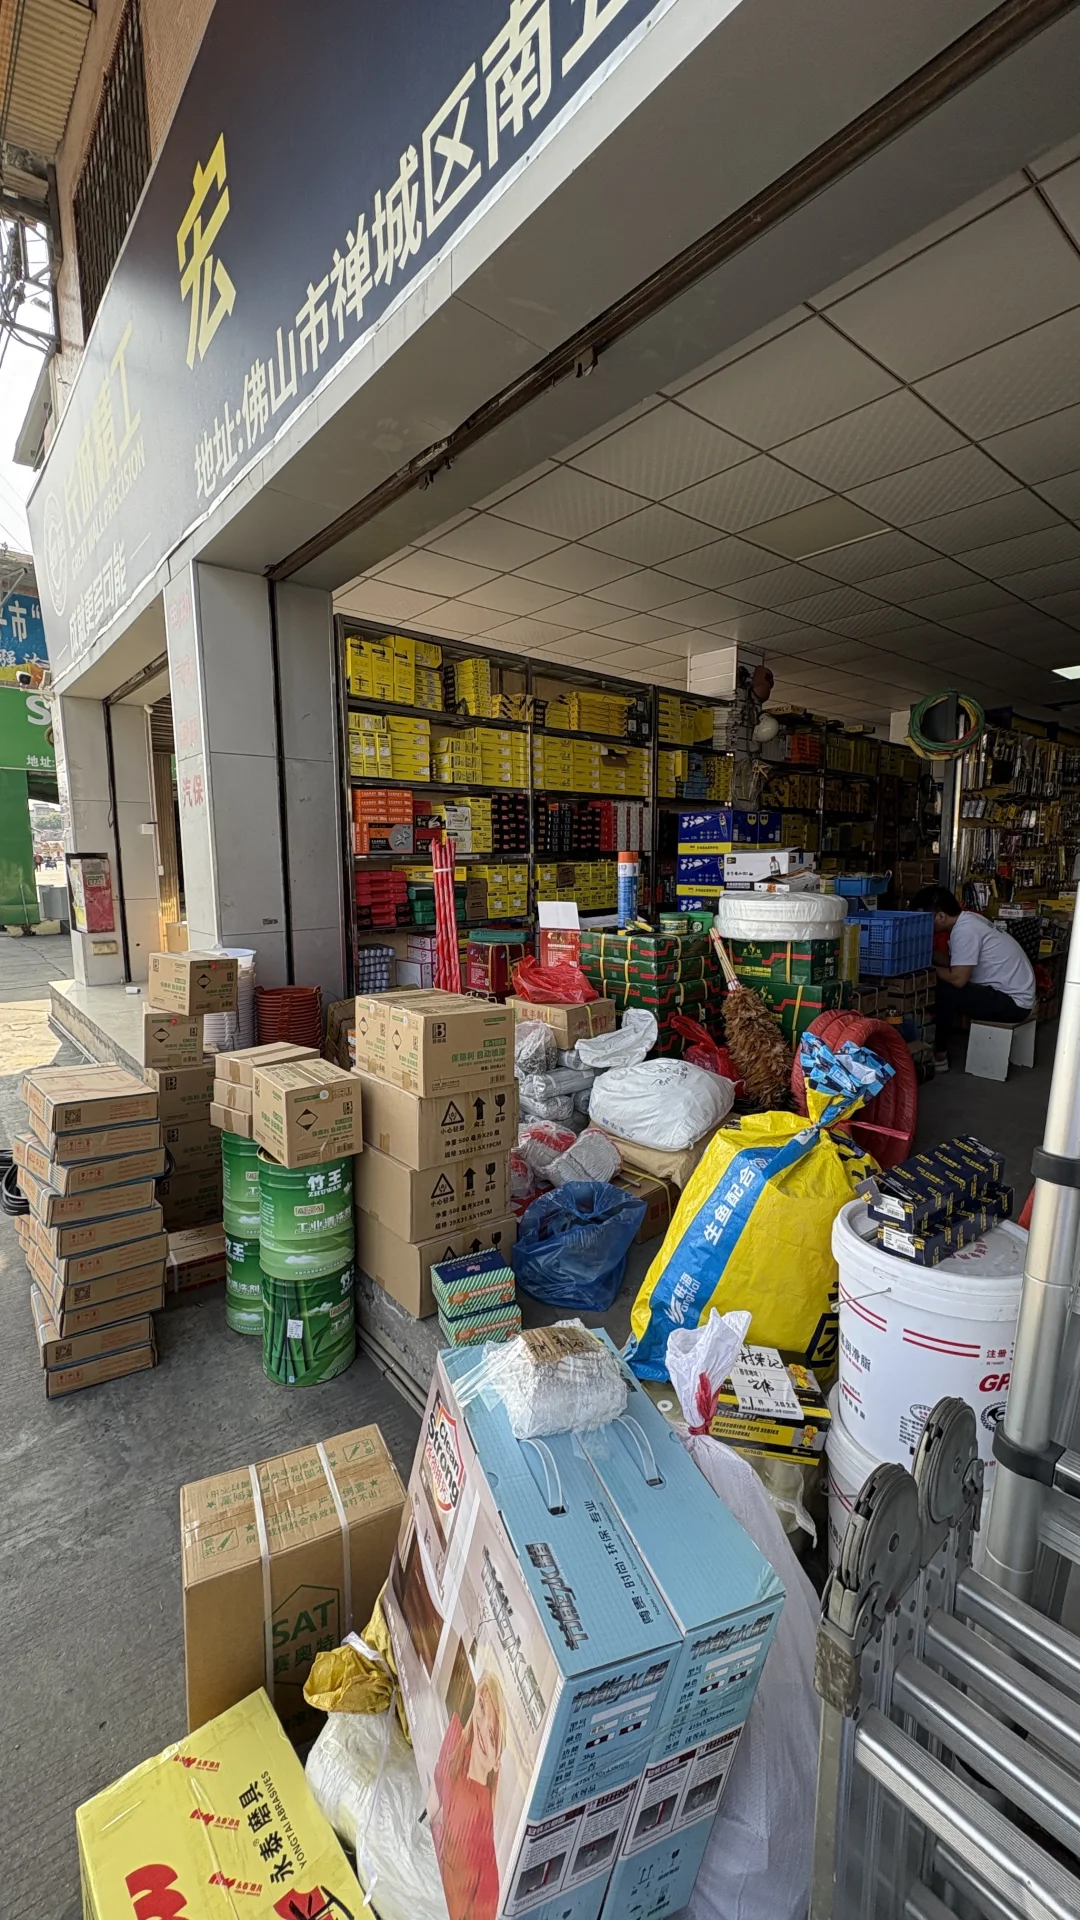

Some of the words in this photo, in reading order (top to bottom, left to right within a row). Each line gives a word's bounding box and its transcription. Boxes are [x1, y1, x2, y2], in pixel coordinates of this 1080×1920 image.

[176, 131, 236, 370] 宏
[63, 320, 142, 549] 长城精工
[103, 436, 146, 522] PRECISION
[68, 540, 128, 660] 成就更多可能
[182, 774, 204, 808] 汽保
[440, 1124, 465, 1136] 小心轻放
[473, 1120, 486, 1129] 向上
[307, 1168, 343, 1191] 竹王
[430, 1195, 455, 1208] 小心轻放
[464, 1189, 477, 1199] 向上
[986, 1348, 1008, 1359] 注册
[440, 1421, 460, 1476] Clean
[712, 1427, 751, 1438] PROFESSIONAL
[714, 1421, 748, 1432] MEASURING
[747, 1425, 761, 1433] TAPE
[760, 1427, 779, 1436] SERIES
[428, 1411, 460, 1509] Strong
[272, 1598, 336, 1649] SAT
[272, 1633, 335, 1677] 赛奥特
[260, 1770, 291, 1823] ABRASIVES
[239, 1780, 295, 1885] 永泰磨具
[283, 1821, 308, 1870] YONGTAI
